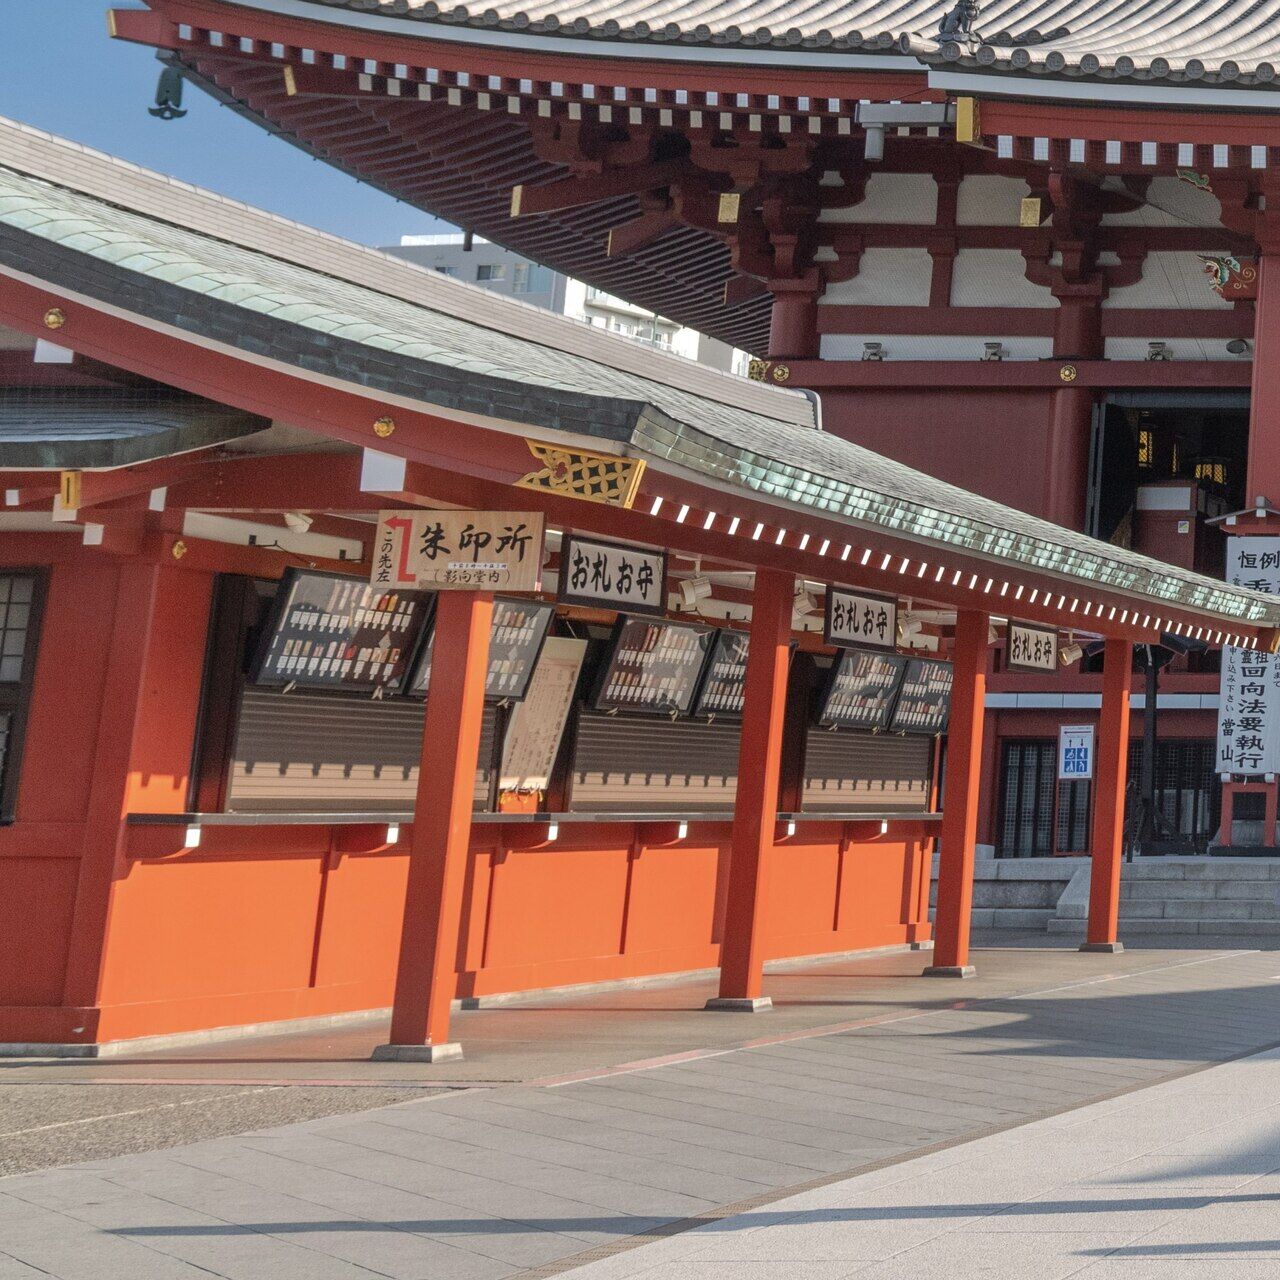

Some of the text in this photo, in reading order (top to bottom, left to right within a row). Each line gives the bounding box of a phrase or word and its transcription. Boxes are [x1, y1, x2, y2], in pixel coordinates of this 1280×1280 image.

[376, 531, 393, 583] この先左
[419, 522, 534, 563] 朱印所
[1237, 549, 1280, 570] 恒例
[571, 547, 654, 601] お札お守
[832, 599, 888, 641] お札お守
[1012, 631, 1053, 665] お札お守
